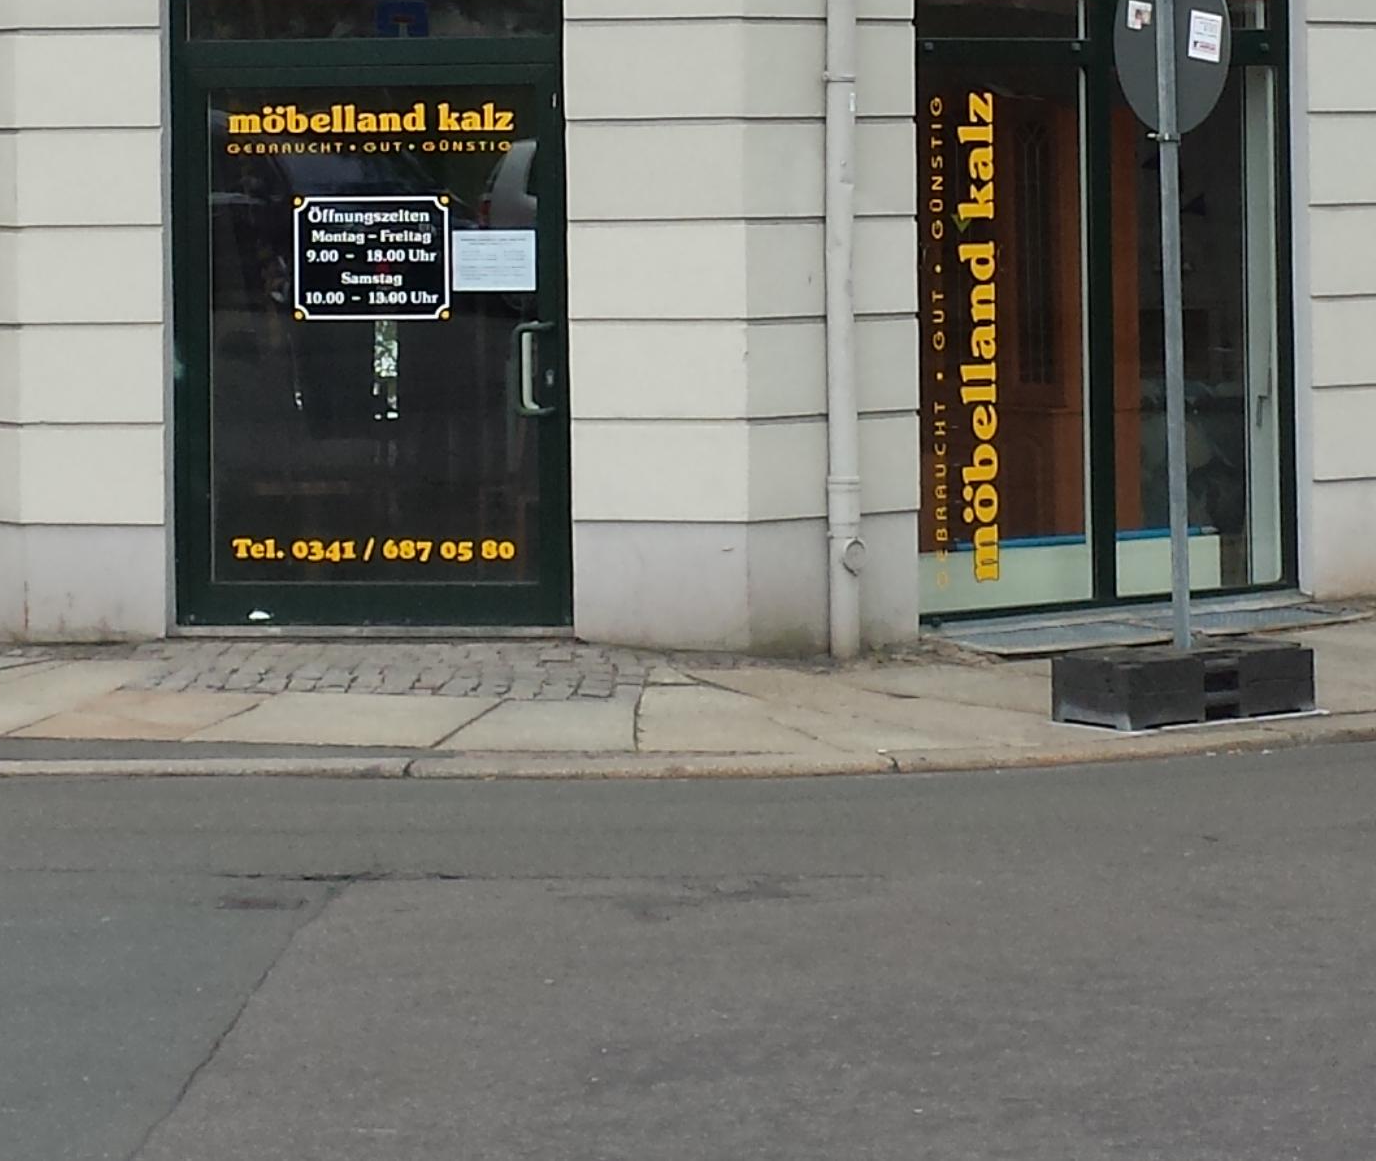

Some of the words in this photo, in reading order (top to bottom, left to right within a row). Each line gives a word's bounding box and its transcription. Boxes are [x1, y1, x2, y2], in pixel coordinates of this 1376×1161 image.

[229, 103, 426, 133] möbelland
[438, 102, 514, 131] kalz
[227, 141, 343, 154] GEBRAUCHT
[363, 141, 403, 153] GUT
[422, 139, 512, 152] GÜNSTIG
[957, 92, 994, 219] kalz
[308, 206, 430, 225] Öffnungszeiten
[311, 230, 365, 245] Montag
[380, 230, 432, 245] Freitag
[306, 249, 339, 262] 9.00
[366, 249, 405, 262] 18.00
[408, 249, 437, 262] Uhr
[341, 272, 403, 286] Samstag
[305, 291, 344, 304] 10.00
[410, 291, 439, 304] Uhr
[932, 291, 945, 350] GUT
[958, 241, 999, 582] möbelland
[232, 538, 285, 559] Tel.
[292, 540, 356, 561] 0341
[383, 539, 433, 561] 687
[440, 541, 474, 561] 05
[481, 539, 515, 560] 80
